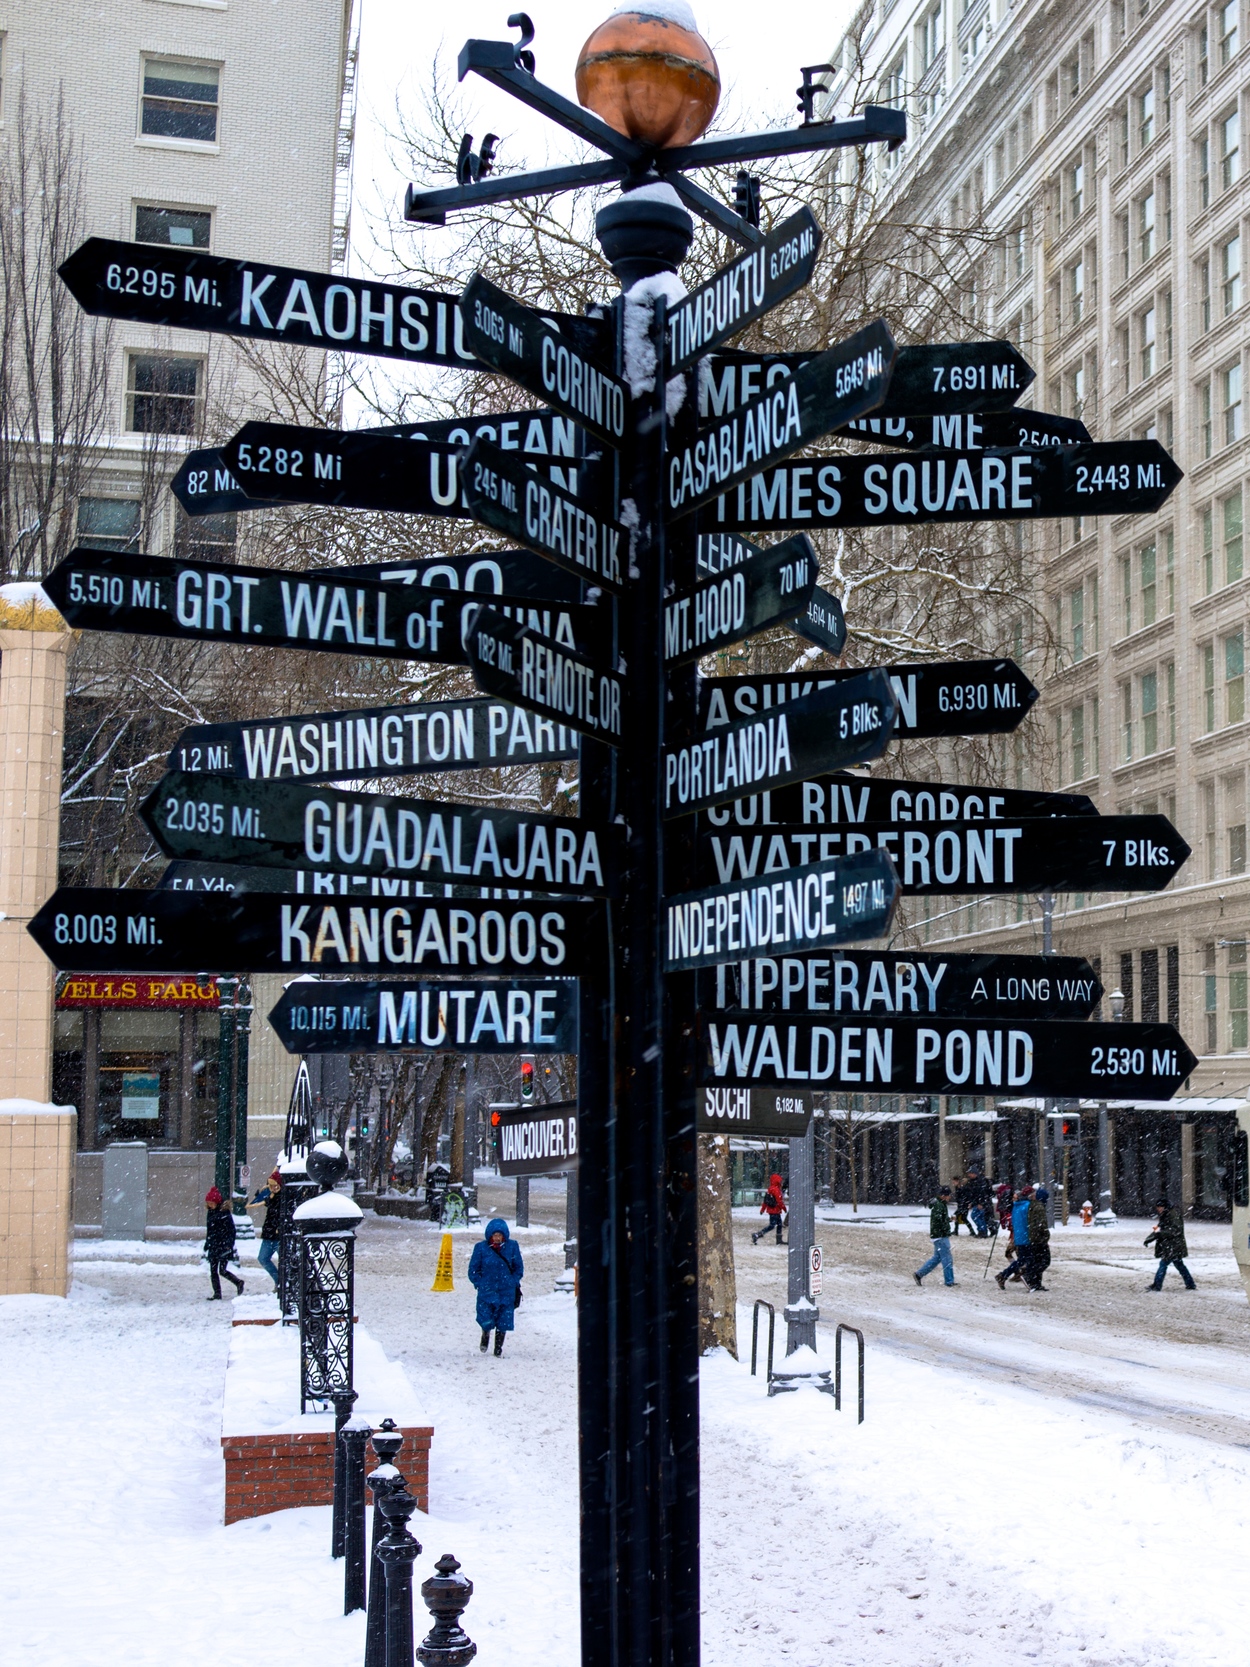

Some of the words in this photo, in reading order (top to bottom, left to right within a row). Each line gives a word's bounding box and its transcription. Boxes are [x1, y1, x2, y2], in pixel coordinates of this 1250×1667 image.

[107, 263, 177, 299] 6,295
[184, 275, 222, 307] Mi.
[240, 270, 482, 364] KAOHSIU
[668, 246, 766, 367] TIMBUKTU
[770, 237, 799, 281] 6,726
[542, 335, 625, 438] CORINTO
[932, 366, 986, 394] 7,691
[992, 364, 1020, 389] Mi.
[238, 443, 304, 477] 5,282
[314, 452, 343, 481] Mi
[669, 381, 802, 509] CASABLANCA
[932, 413, 983, 450] ME
[187, 470, 208, 495] 82
[863, 455, 1033, 515] SQUARE
[1075, 465, 1131, 496] 2,443
[1137, 463, 1166, 489] Mi.
[474, 461, 498, 501] 245
[525, 479, 598, 573] CRATER
[601, 522, 624, 586] LK.
[69, 573, 124, 606] 5,510
[131, 579, 168, 611] Mi.
[177, 569, 263, 633] GRT.
[281, 580, 396, 647] WALL
[406, 599, 444, 651] of
[460, 602, 577, 652] CNA
[664, 597, 693, 660] MT.
[694, 572, 746, 647] HOOD
[779, 563, 793, 596] 70
[795, 557, 809, 590] Mi
[476, 631, 496, 667] 182
[498, 640, 516, 676] Mi.
[938, 683, 988, 714] 6,930
[993, 683, 1022, 709] Mi.
[180, 747, 202, 772] 1.2
[207, 745, 233, 771] Mi.
[242, 707, 474, 780] WASHINGTON
[665, 713, 792, 809] PORTLANDIA
[839, 708, 848, 739] 5
[852, 701, 882, 736] Blks.
[166, 797, 224, 835] 2,035
[231, 806, 266, 839] Mi.
[304, 800, 604, 887] GUADALAJARA
[1102, 841, 1117, 867] 7
[1125, 839, 1176, 867] Blks.
[53, 915, 117, 948] 8,003
[127, 915, 163, 945] Mi.
[281, 904, 566, 966] KANGAROOS
[667, 871, 837, 960] INDEPENDENCE
[148, 982, 221, 999] FARG
[716, 957, 947, 1012] TIPPERARY
[971, 977, 986, 1000] A
[996, 978, 1050, 1001] LONG
[1056, 979, 1094, 1001] WAY
[289, 1005, 337, 1033] 10,115
[342, 1005, 371, 1031] Mi.
[378, 990, 557, 1047] MUTARE
[708, 1023, 893, 1084] WALDEN
[915, 1028, 1033, 1086] POND
[1090, 1047, 1145, 1076] 2,530
[1152, 1048, 1182, 1077] Mi.
[705, 1087, 751, 1120] SOCHI
[775, 1096, 794, 1114] 6,182
[795, 1098, 805, 1114] Mi.
[501, 1118, 567, 1161] VANCOUVER,
